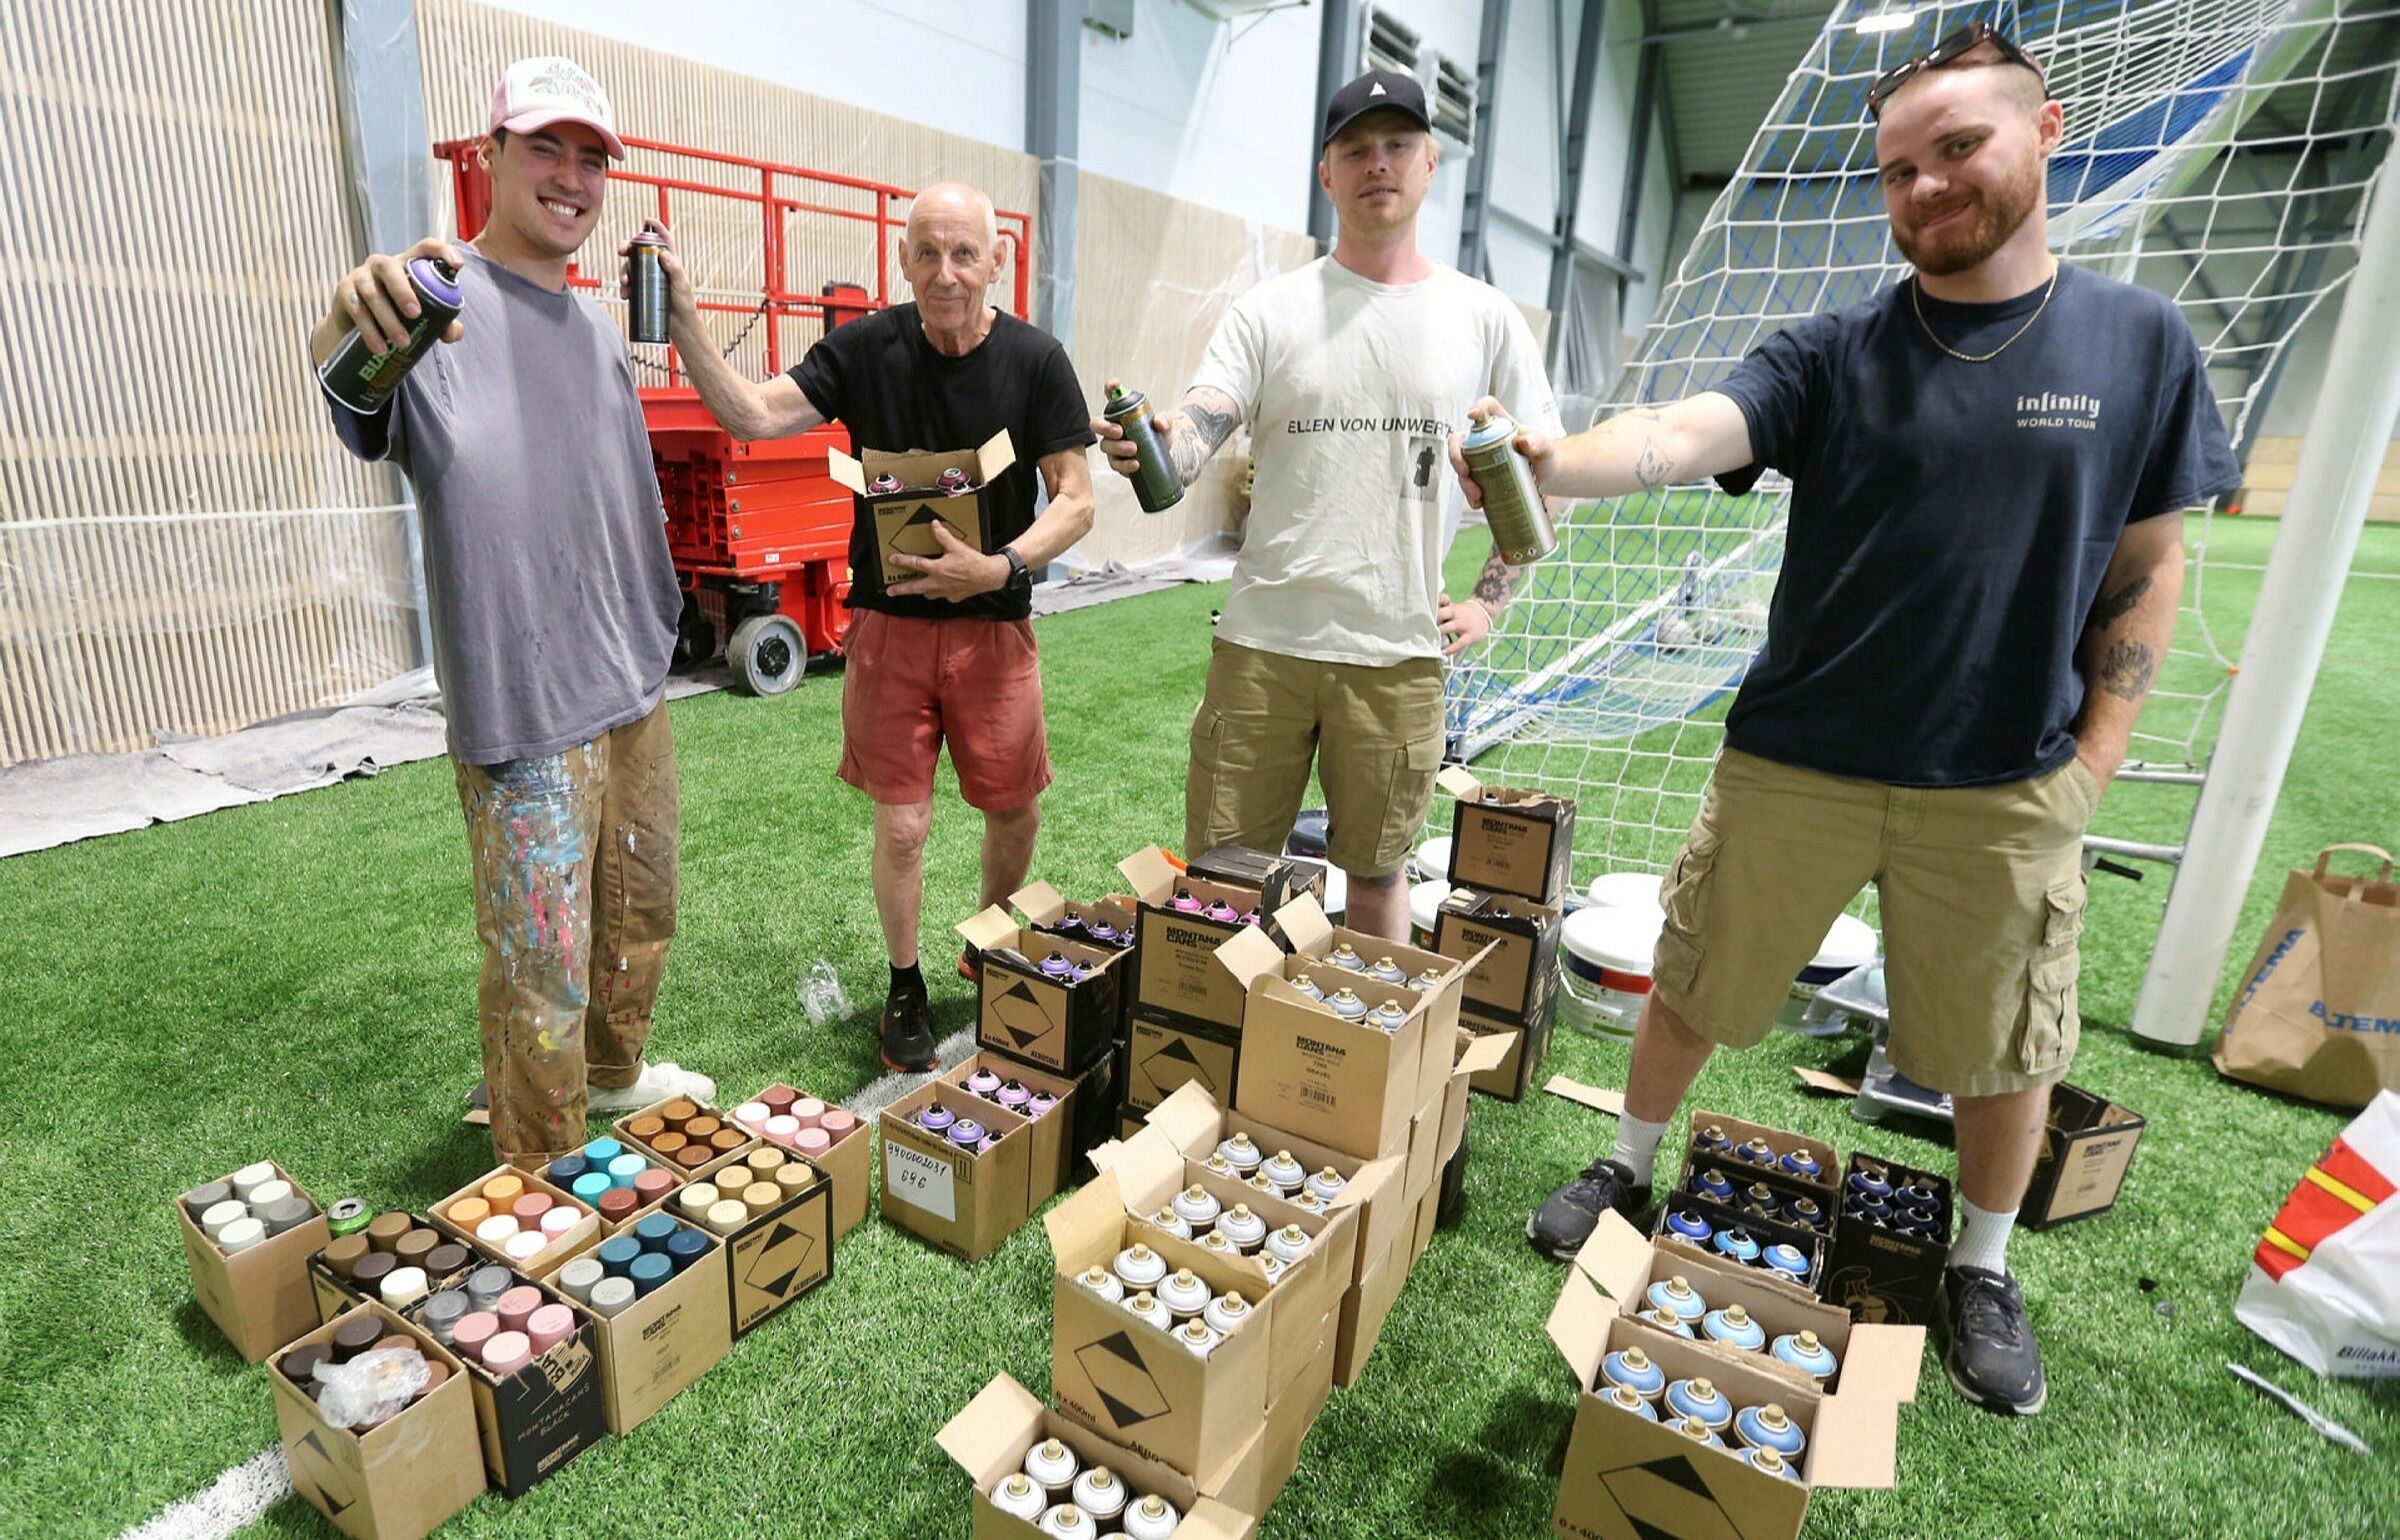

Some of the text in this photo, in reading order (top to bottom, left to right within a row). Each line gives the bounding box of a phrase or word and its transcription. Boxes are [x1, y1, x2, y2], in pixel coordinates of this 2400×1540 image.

[2017, 391, 2100, 418] infinity
[1287, 418, 1335, 434] ELLEN
[1340, 417, 1377, 432] VON
[2017, 418, 2096, 430] WORLD TOUR
[1166, 926, 1221, 945] MONTANA
[1166, 934, 1198, 949] CANS
[1296, 1035, 1346, 1056] MONTANA
[540, 1409, 570, 1437] BLACK
